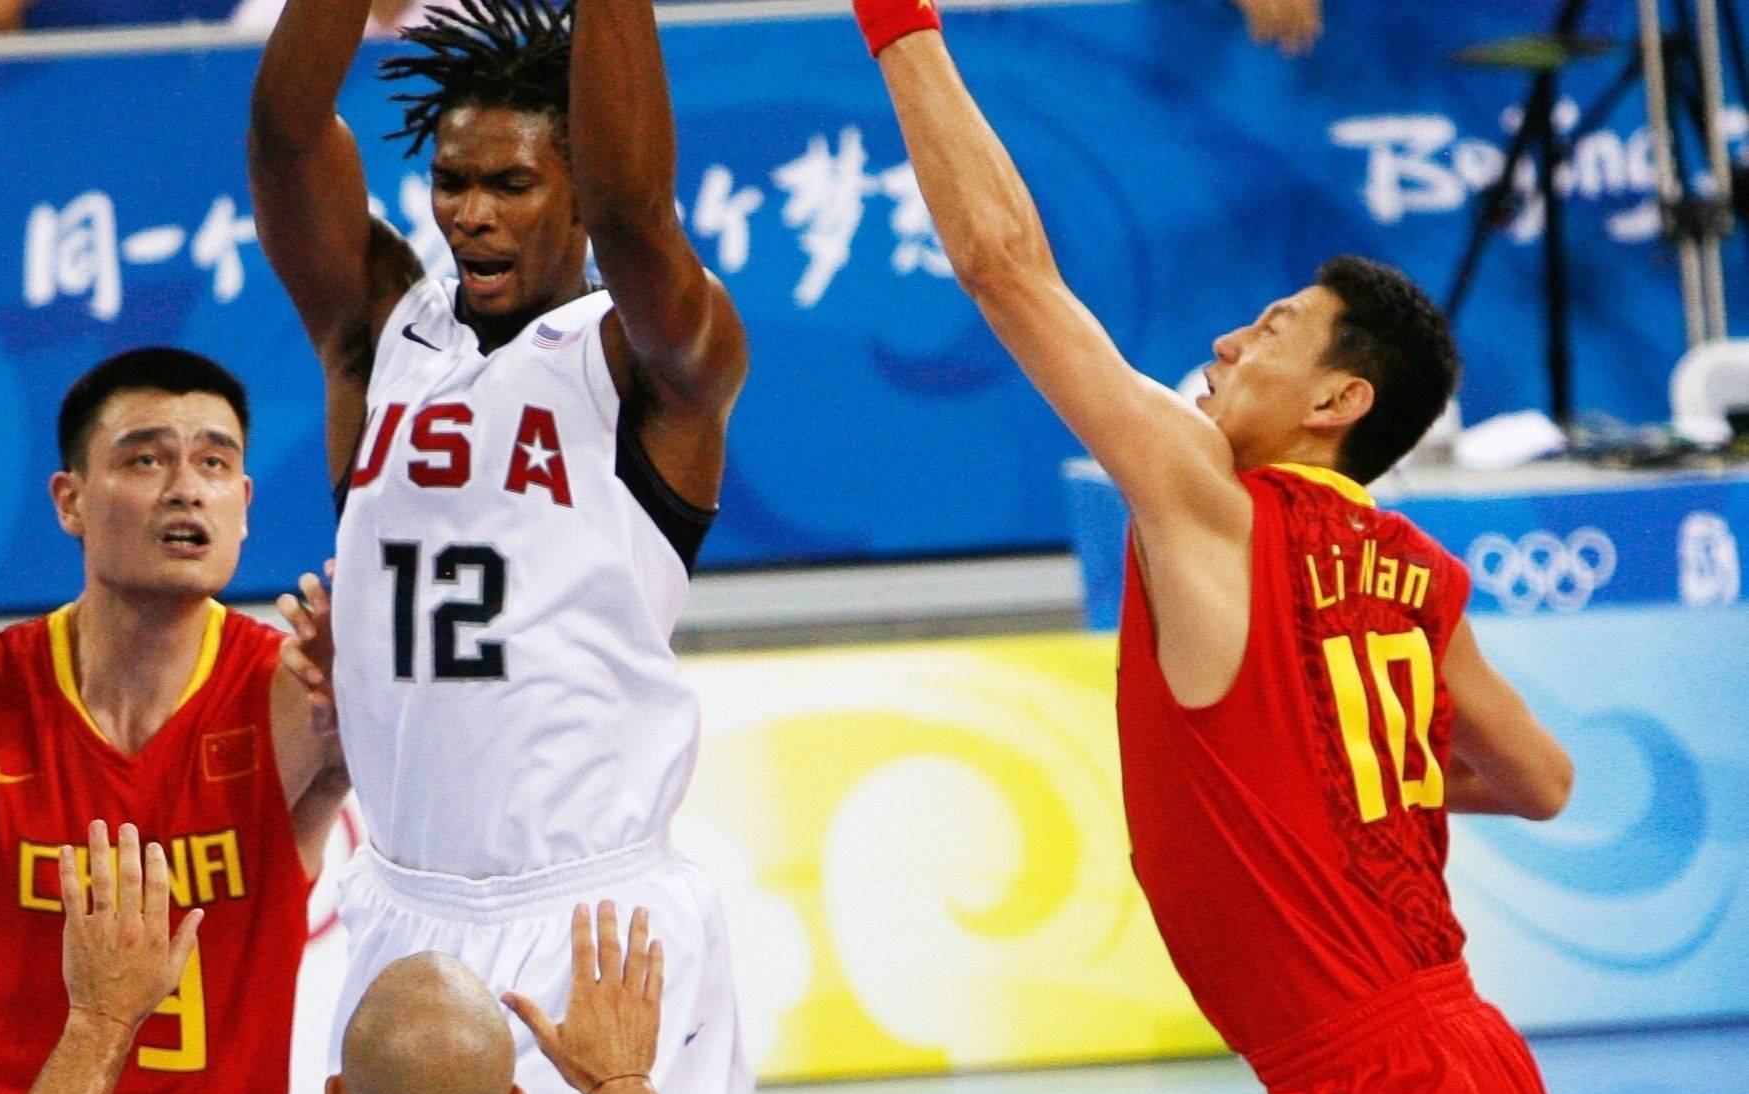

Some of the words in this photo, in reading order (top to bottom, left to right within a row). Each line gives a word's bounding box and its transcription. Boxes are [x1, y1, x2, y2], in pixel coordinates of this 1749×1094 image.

[351, 402, 574, 509] USA
[379, 539, 509, 683] 12
[1306, 543, 1345, 609] Li
[1359, 538, 1431, 609] Nan
[1322, 626, 1445, 823] 10
[19, 829, 245, 912] CHNA
